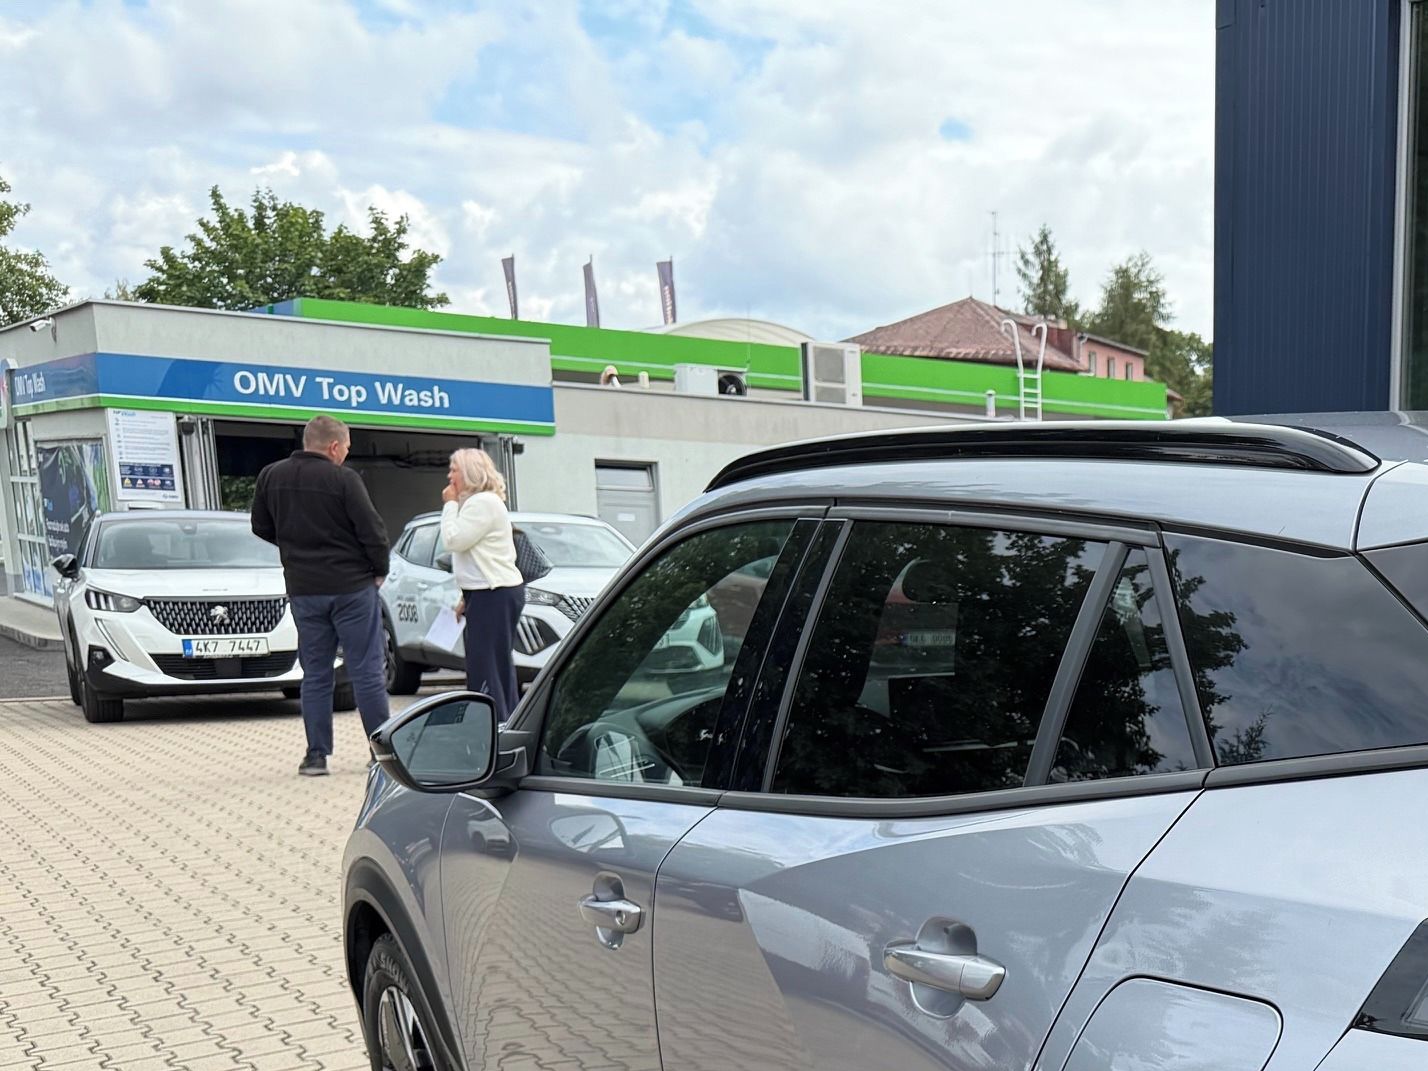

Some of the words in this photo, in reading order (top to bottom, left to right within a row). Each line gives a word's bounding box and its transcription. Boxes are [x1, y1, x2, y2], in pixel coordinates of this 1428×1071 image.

[233, 370, 307, 398] OMV
[315, 377, 367, 407] Top
[374, 381, 450, 408] Wash
[397, 603, 419, 623] 2008
[196, 640, 218, 653] 4K7
[229, 639, 260, 652] 7447
